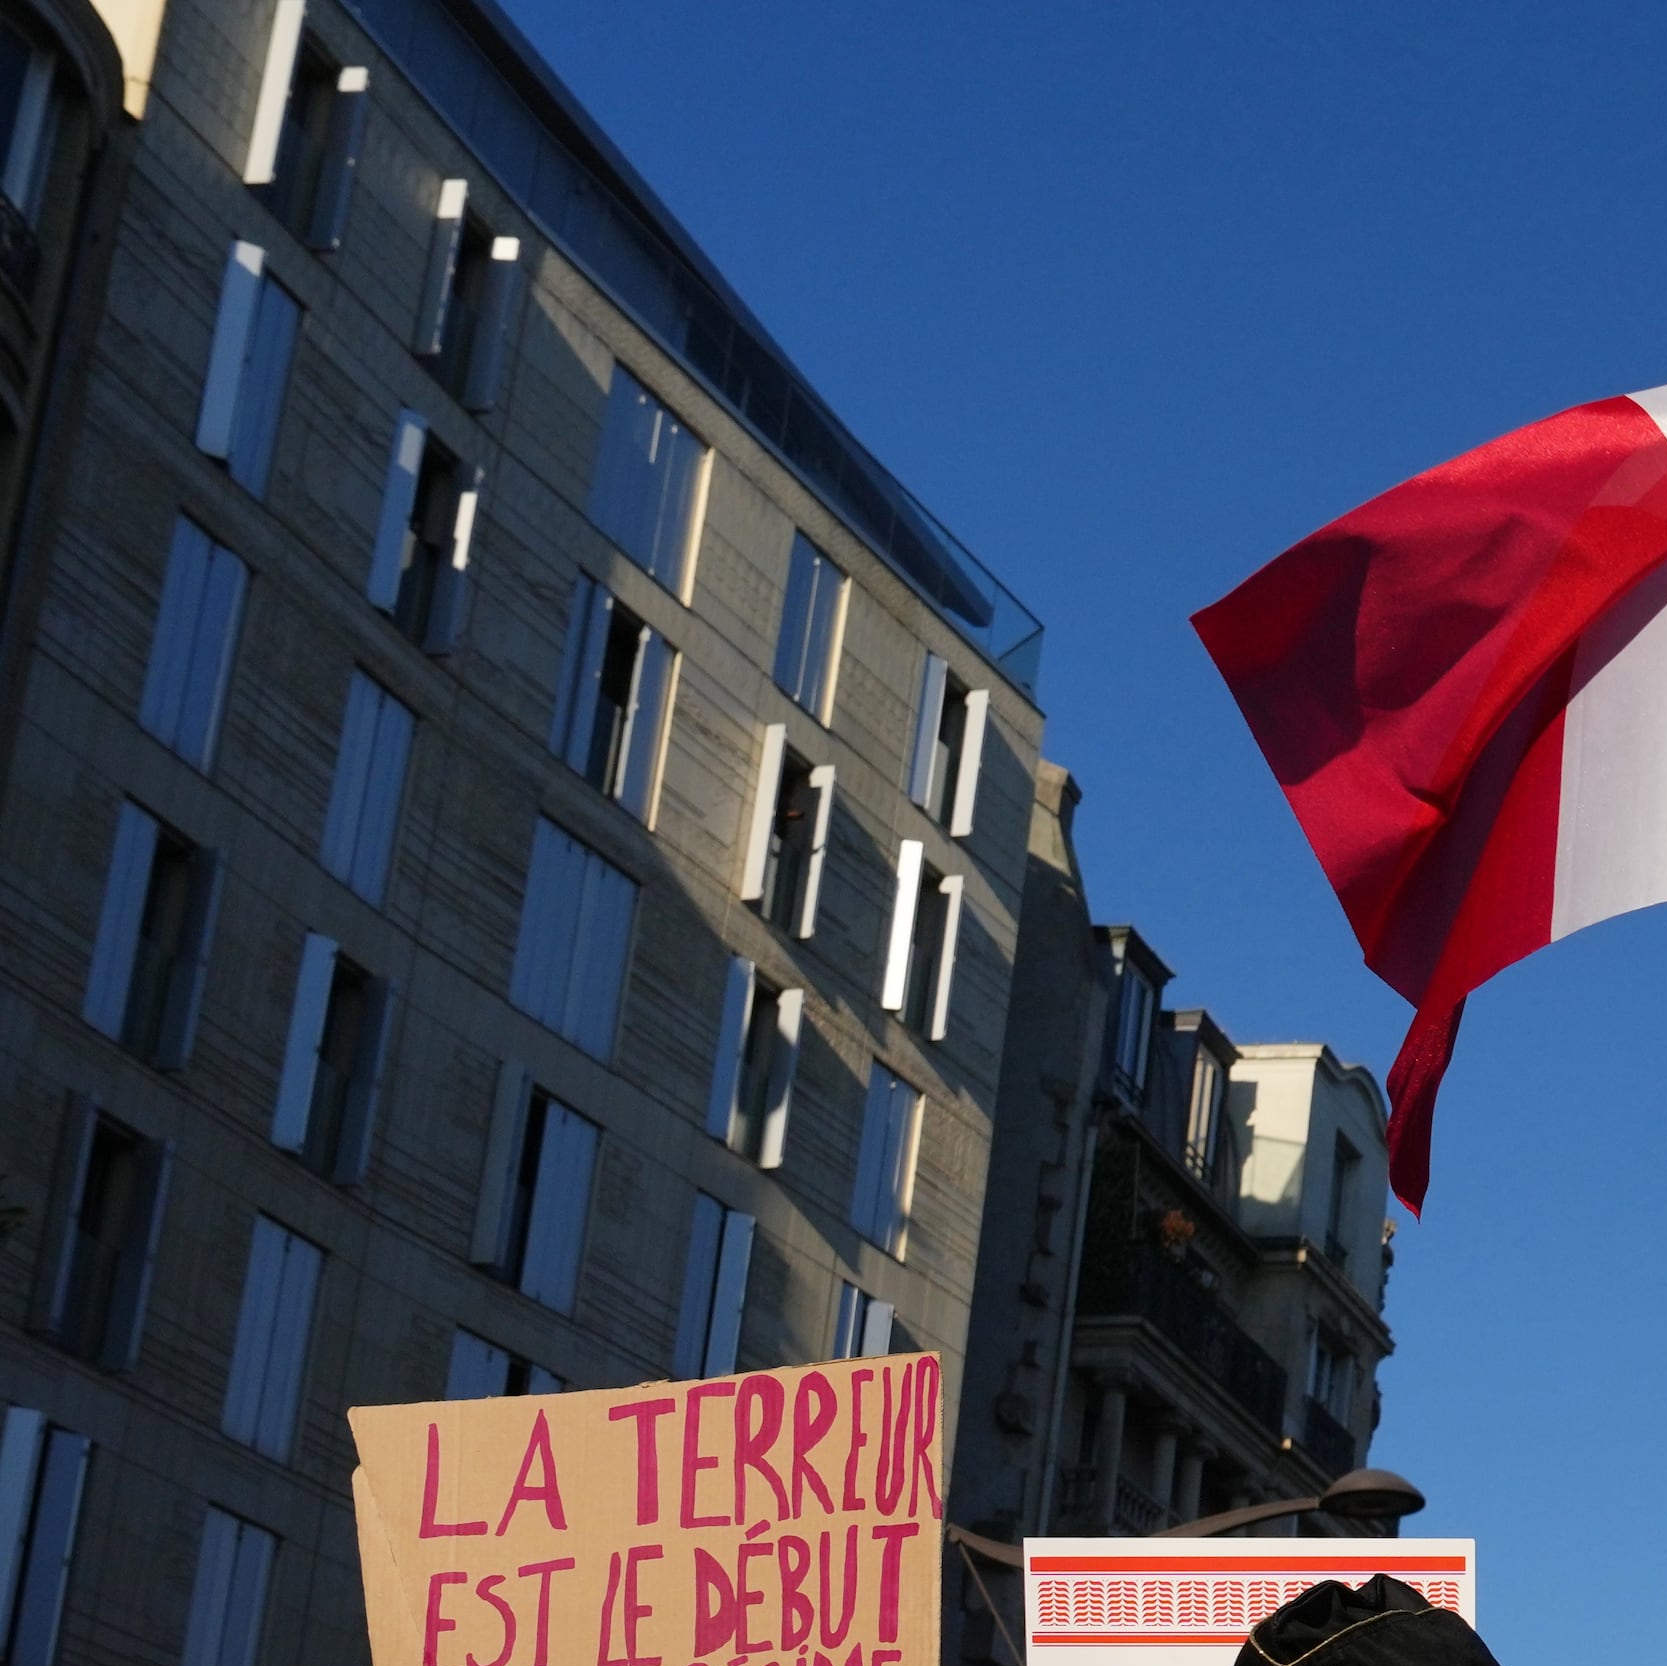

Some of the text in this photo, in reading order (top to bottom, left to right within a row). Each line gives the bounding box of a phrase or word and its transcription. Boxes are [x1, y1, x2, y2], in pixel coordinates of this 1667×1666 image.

[418, 1355, 942, 1539] LA TERREUR
[693, 1520, 920, 1659] DÉBUT
